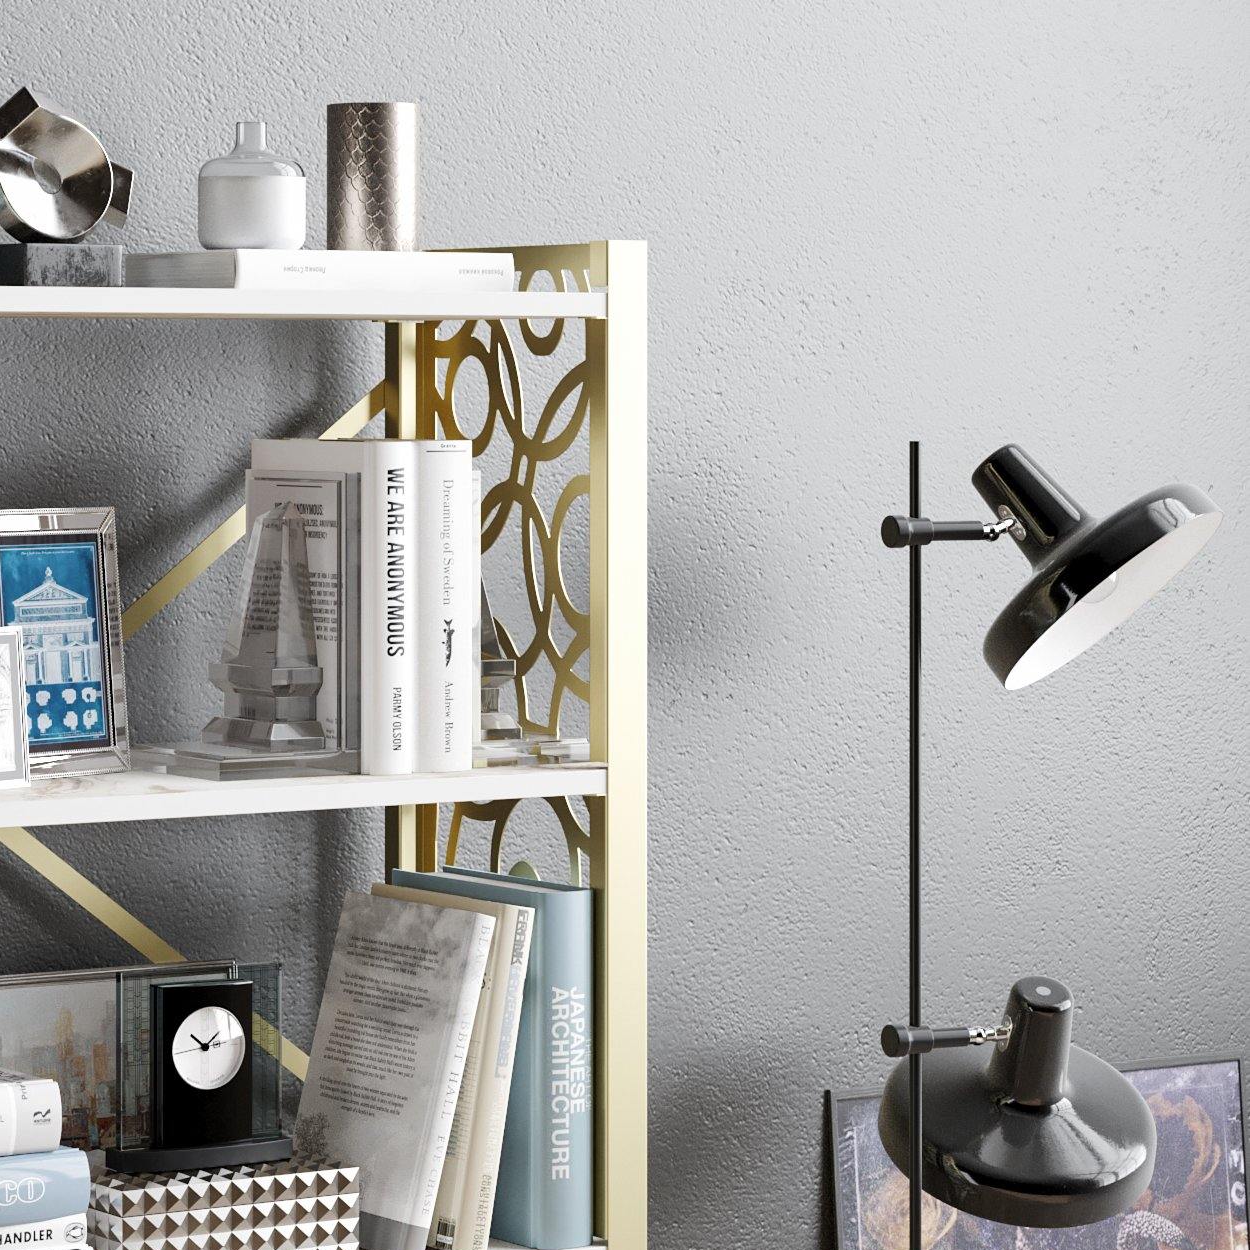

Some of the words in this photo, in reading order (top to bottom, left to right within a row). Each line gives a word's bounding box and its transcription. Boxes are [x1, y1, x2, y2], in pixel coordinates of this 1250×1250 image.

[387, 468, 405, 495] WE
[387, 501, 405, 536] ARE
[440, 479, 454, 539] Dreaming
[387, 542, 405, 658] ANONYMOUS
[442, 558, 454, 606] Sweden
[393, 687, 403, 717] PARMY
[444, 681, 454, 718] Andrew
[392, 721, 402, 752] OLSON
[444, 722, 454, 754] Brown
[512, 909, 529, 965] FRANK
[569, 986, 586, 1113] JAPANESE
[440, 1071, 461, 1120] HALL
[551, 986, 570, 1180] ARCHITECTURE
[433, 1135, 446, 1161] EVE
[422, 1168, 438, 1215] CHASE
